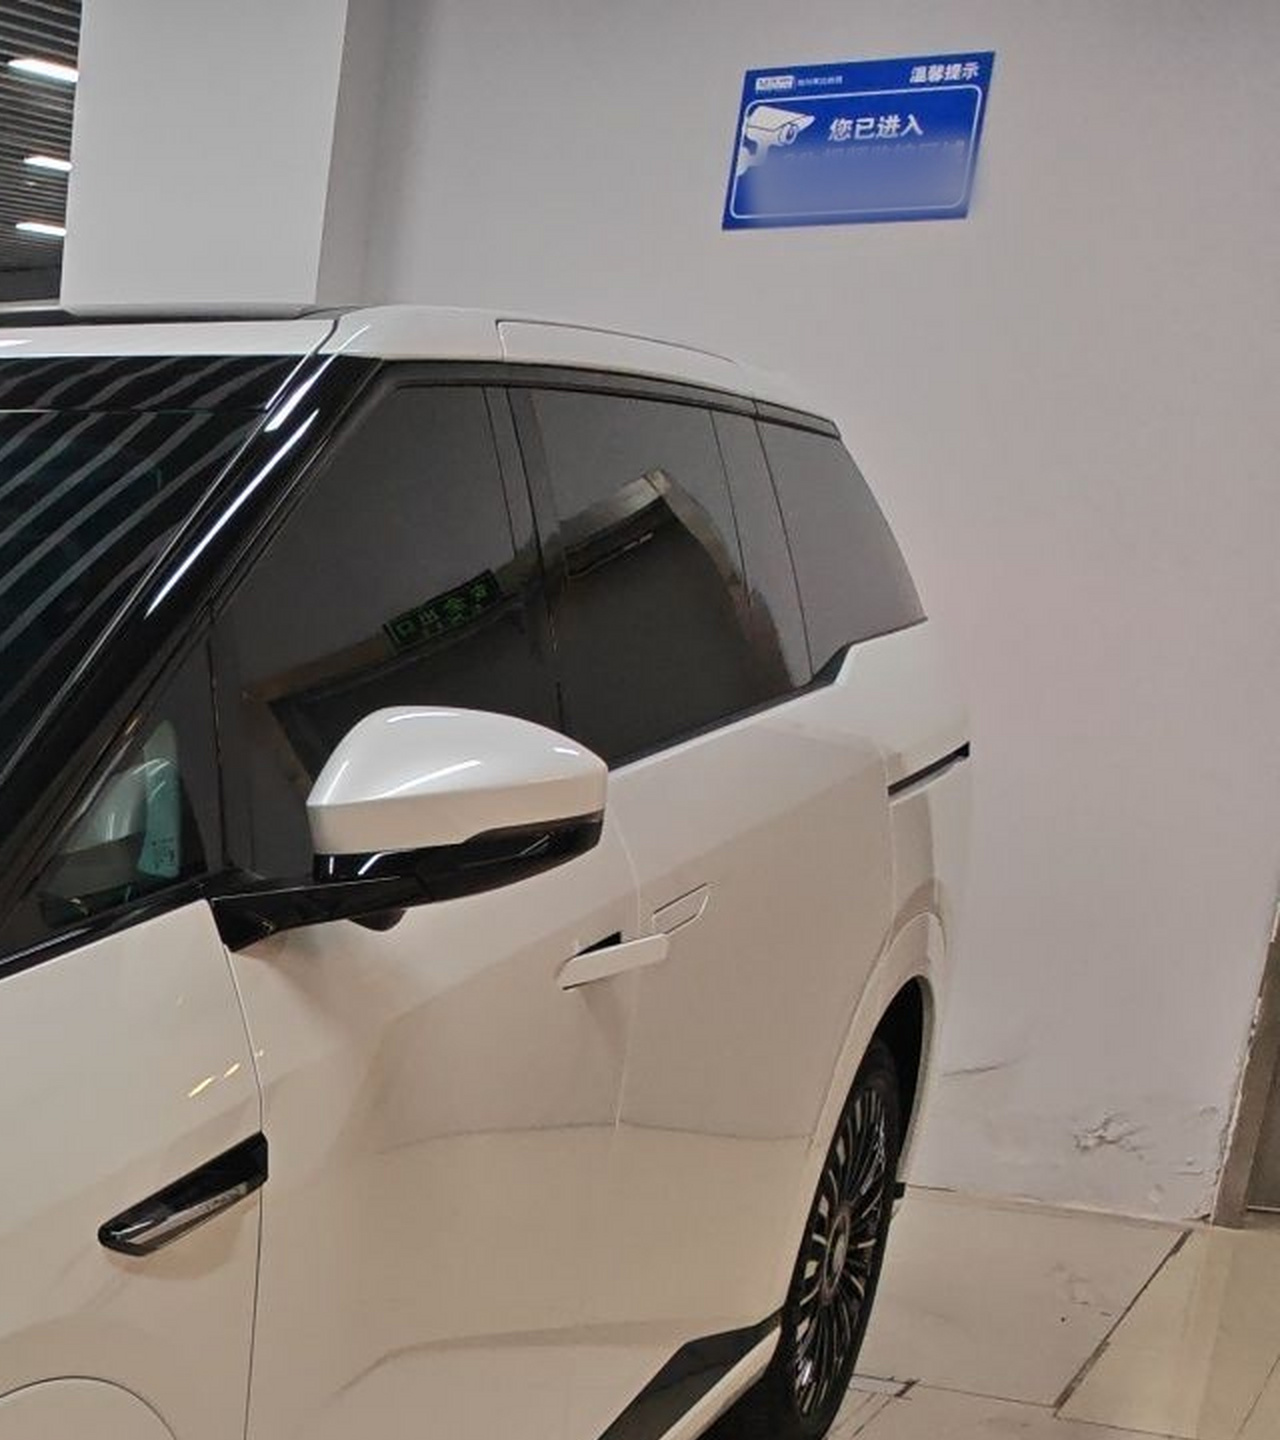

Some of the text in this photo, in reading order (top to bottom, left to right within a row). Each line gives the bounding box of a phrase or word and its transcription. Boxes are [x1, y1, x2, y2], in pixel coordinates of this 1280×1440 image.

[909, 61, 980, 84] 温馨提示
[827, 113, 924, 142] 您已进入
